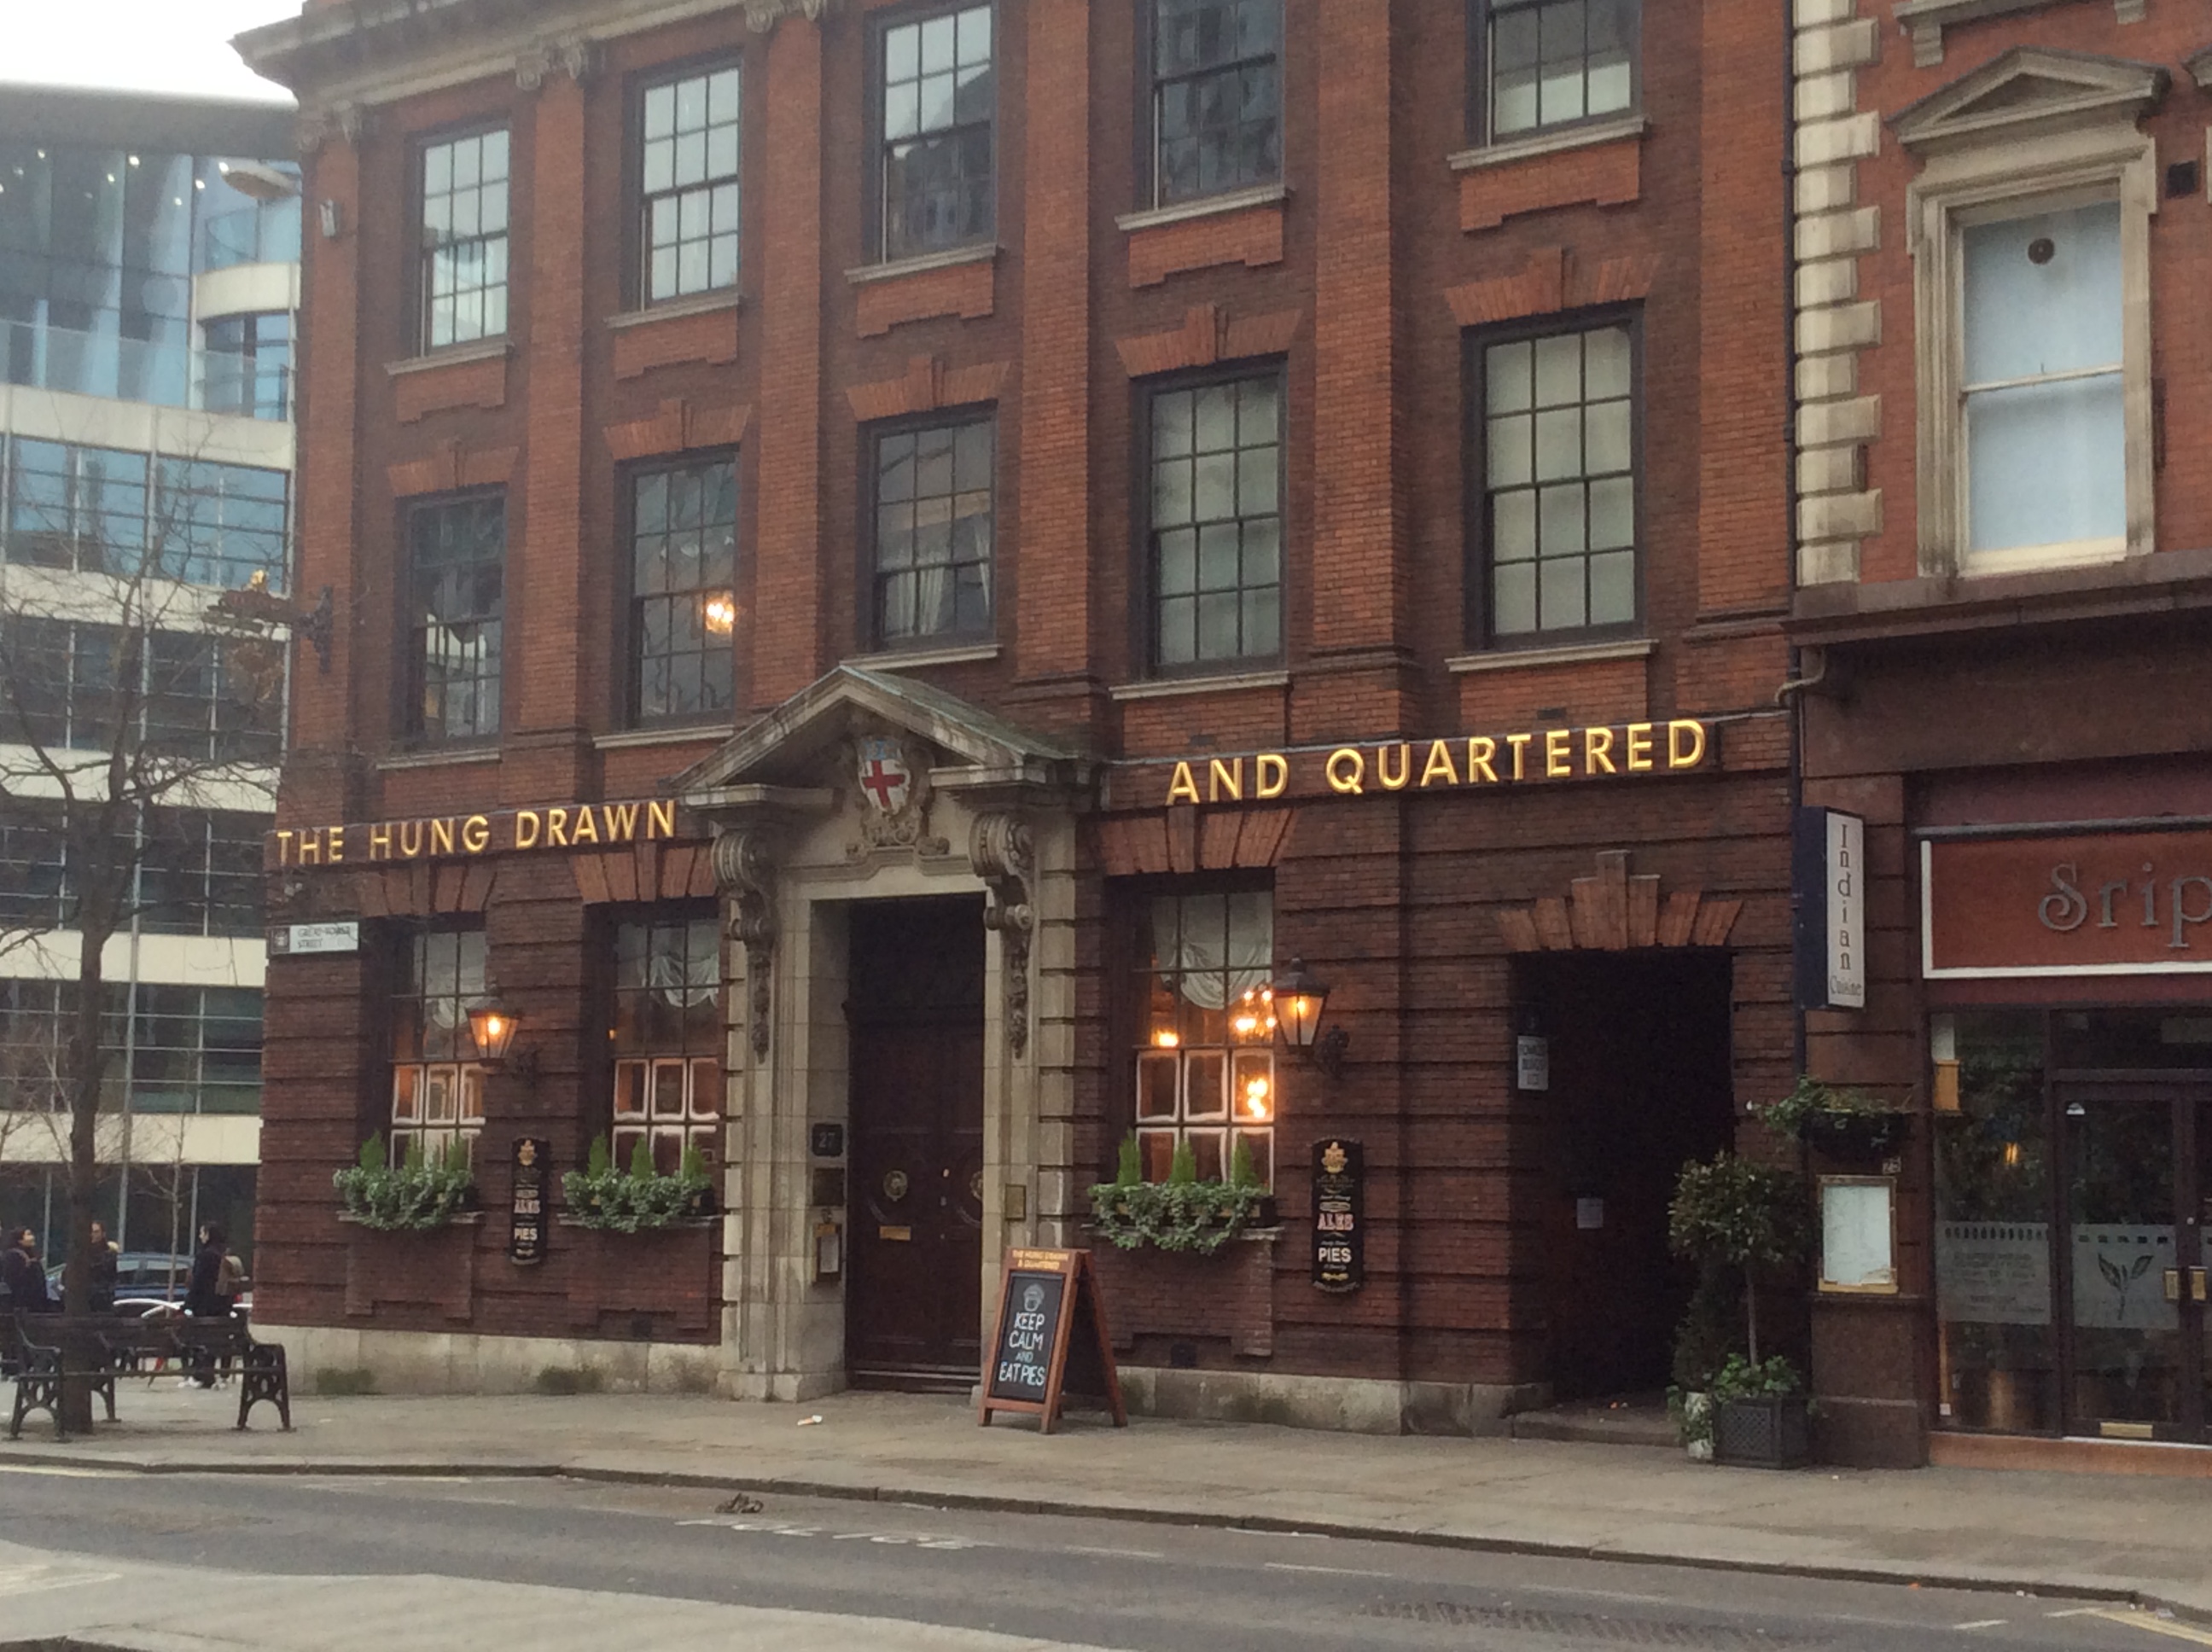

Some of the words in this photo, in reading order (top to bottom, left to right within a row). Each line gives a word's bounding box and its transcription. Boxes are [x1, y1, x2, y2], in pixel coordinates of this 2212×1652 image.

[1166, 757, 1289, 806] AND
[1325, 719, 1707, 794] QUARTERED
[277, 826, 346, 866] THE
[370, 815, 489, 860] HUNG
[515, 800, 677, 850] DRAWN
[818, 1131, 836, 1149] 27
[514, 1228, 537, 1241] PIES
[1318, 1247, 1352, 1263] PIES
[1014, 1312, 1045, 1331] KEEP
[1009, 1330, 1044, 1351] CALM
[1015, 1352, 1033, 1363] AND
[998, 1361, 1021, 1382] EAT
